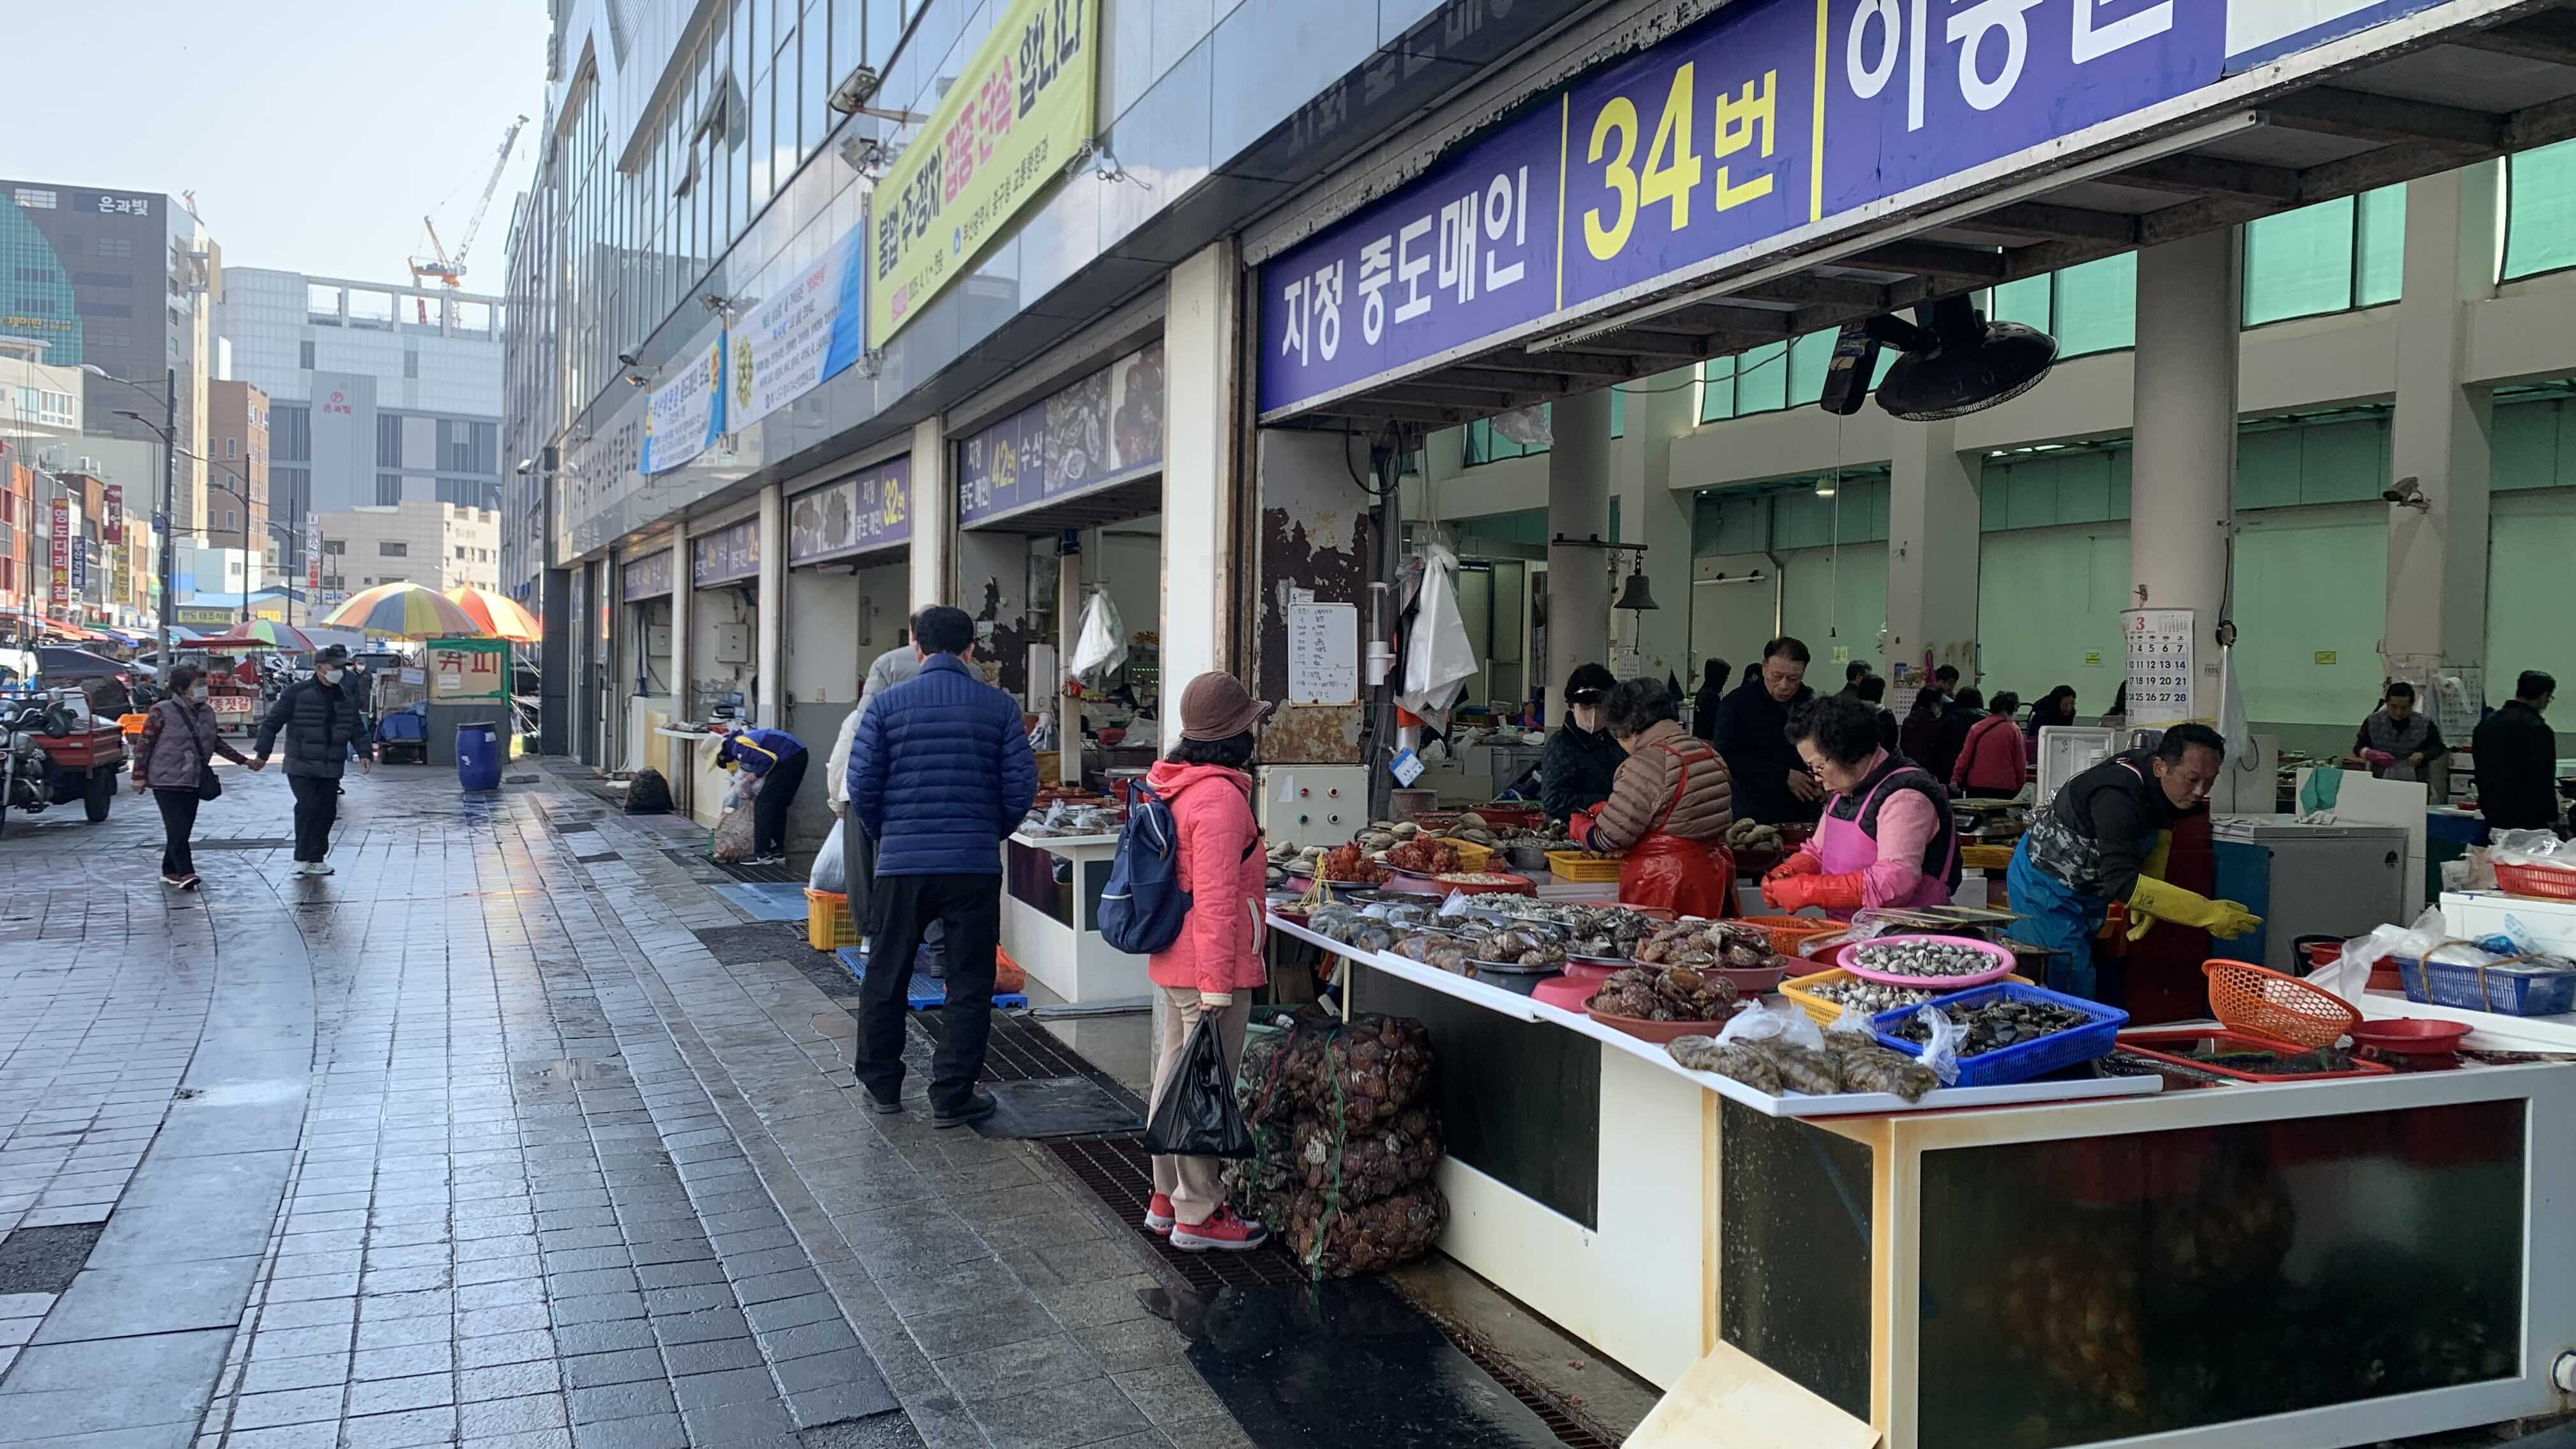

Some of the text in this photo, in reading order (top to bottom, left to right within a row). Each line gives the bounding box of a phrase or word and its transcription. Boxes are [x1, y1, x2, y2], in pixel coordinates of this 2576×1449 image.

[878, 198, 899, 281] 불법
[945, 99, 974, 206] 집중
[980, 54, 1012, 167] 단속
[98, 195, 148, 216] 은과빛
[1282, 259, 1344, 367] 지정
[1358, 165, 1528, 346] 중도매인
[1583, 61, 1777, 261] 34번
[968, 438, 982, 471] 지정
[992, 439, 1016, 489] 42번
[1021, 430, 1043, 473] 수산
[884, 477, 905, 527] 32번
[2136, 617, 2145, 631] 3
[2136, 661, 2143, 669] 11
[2147, 661, 2156, 669] 12
[2159, 661, 2171, 669] 13
[2175, 661, 2186, 669] 14
[2138, 644, 2142, 653] 4
[2149, 644, 2154, 653] 5
[2162, 644, 2168, 653] 6
[2177, 644, 2183, 653] 7
[2135, 693, 2143, 702] 25
[2145, 693, 2157, 702] 26
[2159, 693, 2171, 702] 27
[2174, 693, 2186, 702] 28
